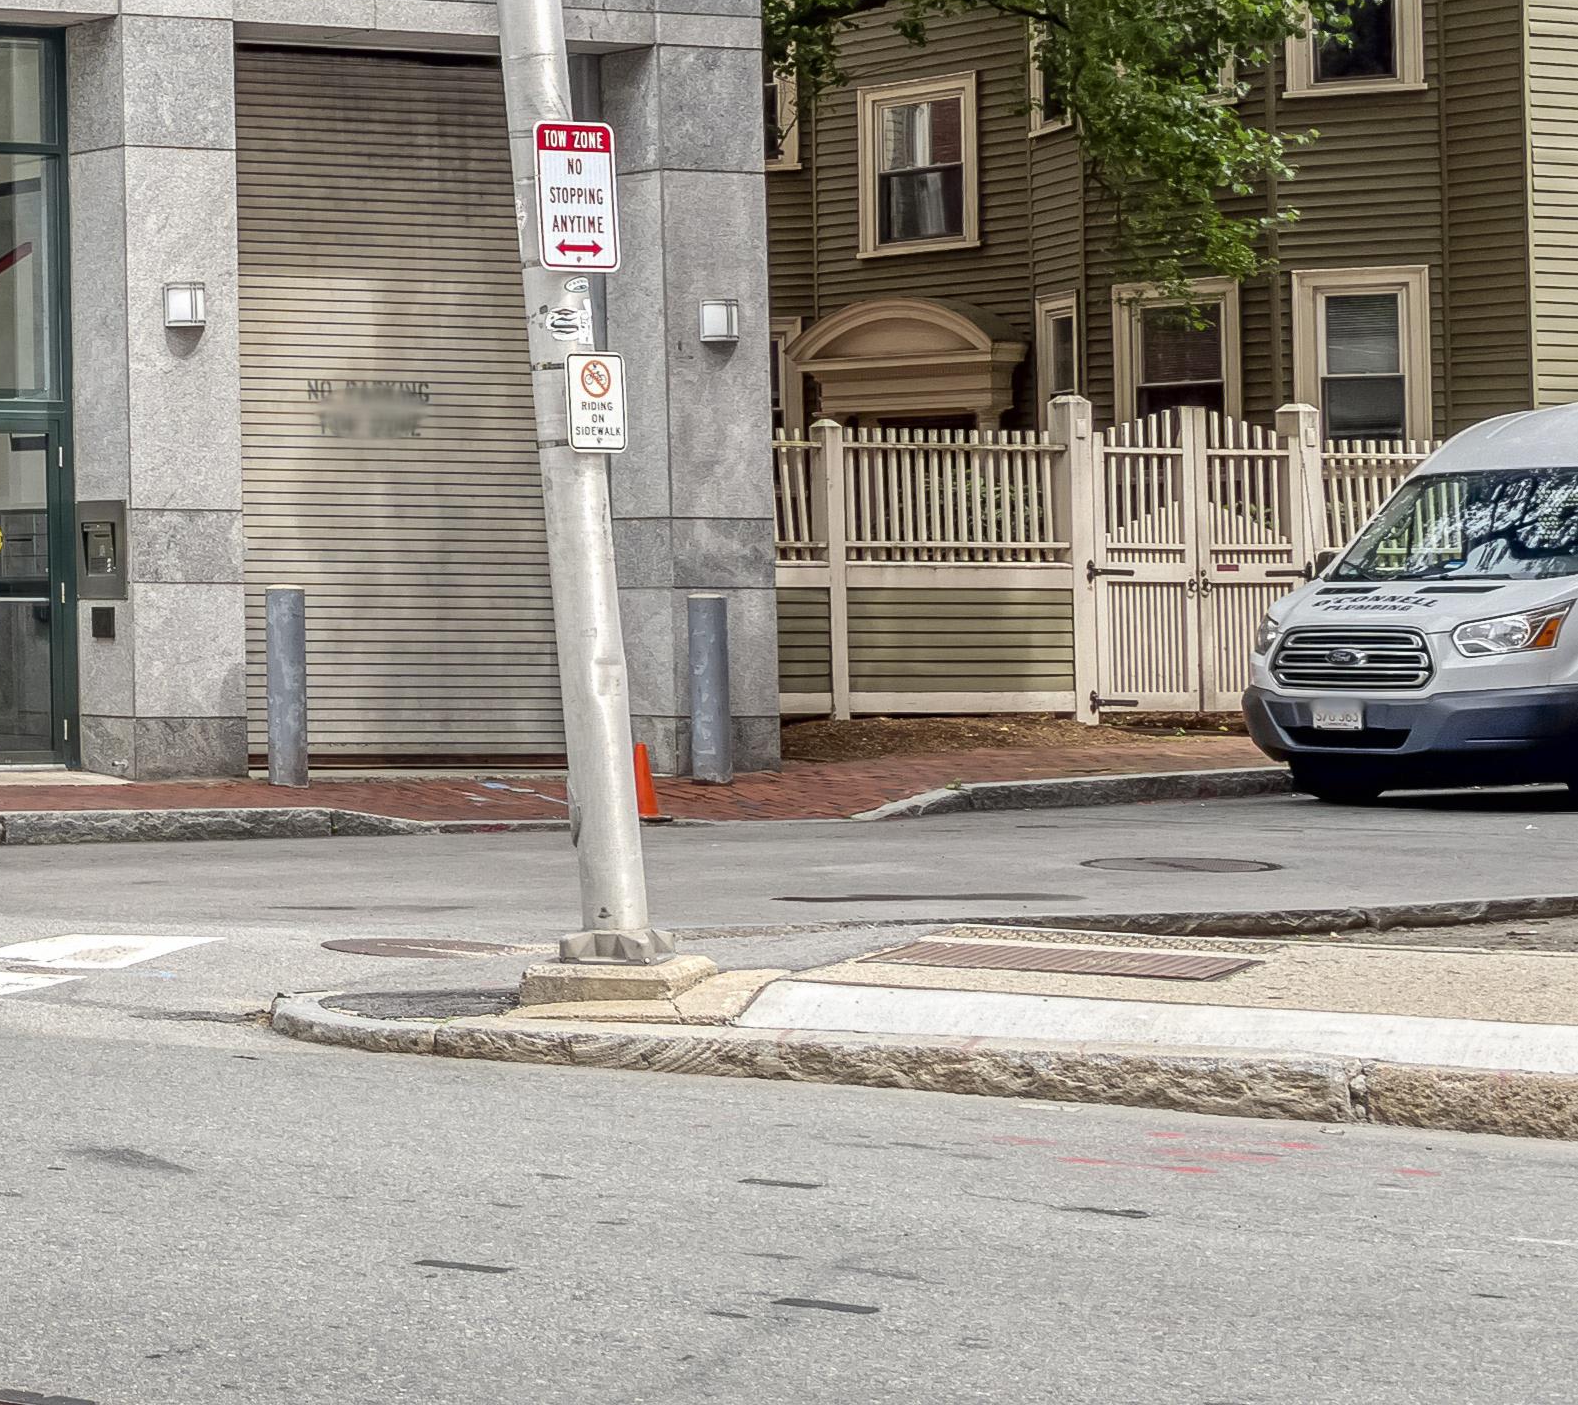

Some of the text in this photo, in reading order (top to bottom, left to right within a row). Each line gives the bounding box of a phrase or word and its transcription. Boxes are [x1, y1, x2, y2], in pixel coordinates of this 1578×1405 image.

[543, 129, 605, 150] TOW ZONE
[567, 158, 583, 176] NO
[549, 186, 604, 206] STOPPING
[552, 215, 605, 234] ANYTIME
[581, 401, 614, 411] RIDING
[591, 413, 605, 423] ON
[575, 426, 622, 436] SIDEWALK
[1311, 595, 1439, 608] O'CONNELL
[1321, 604, 1413, 612] PLUMBING
